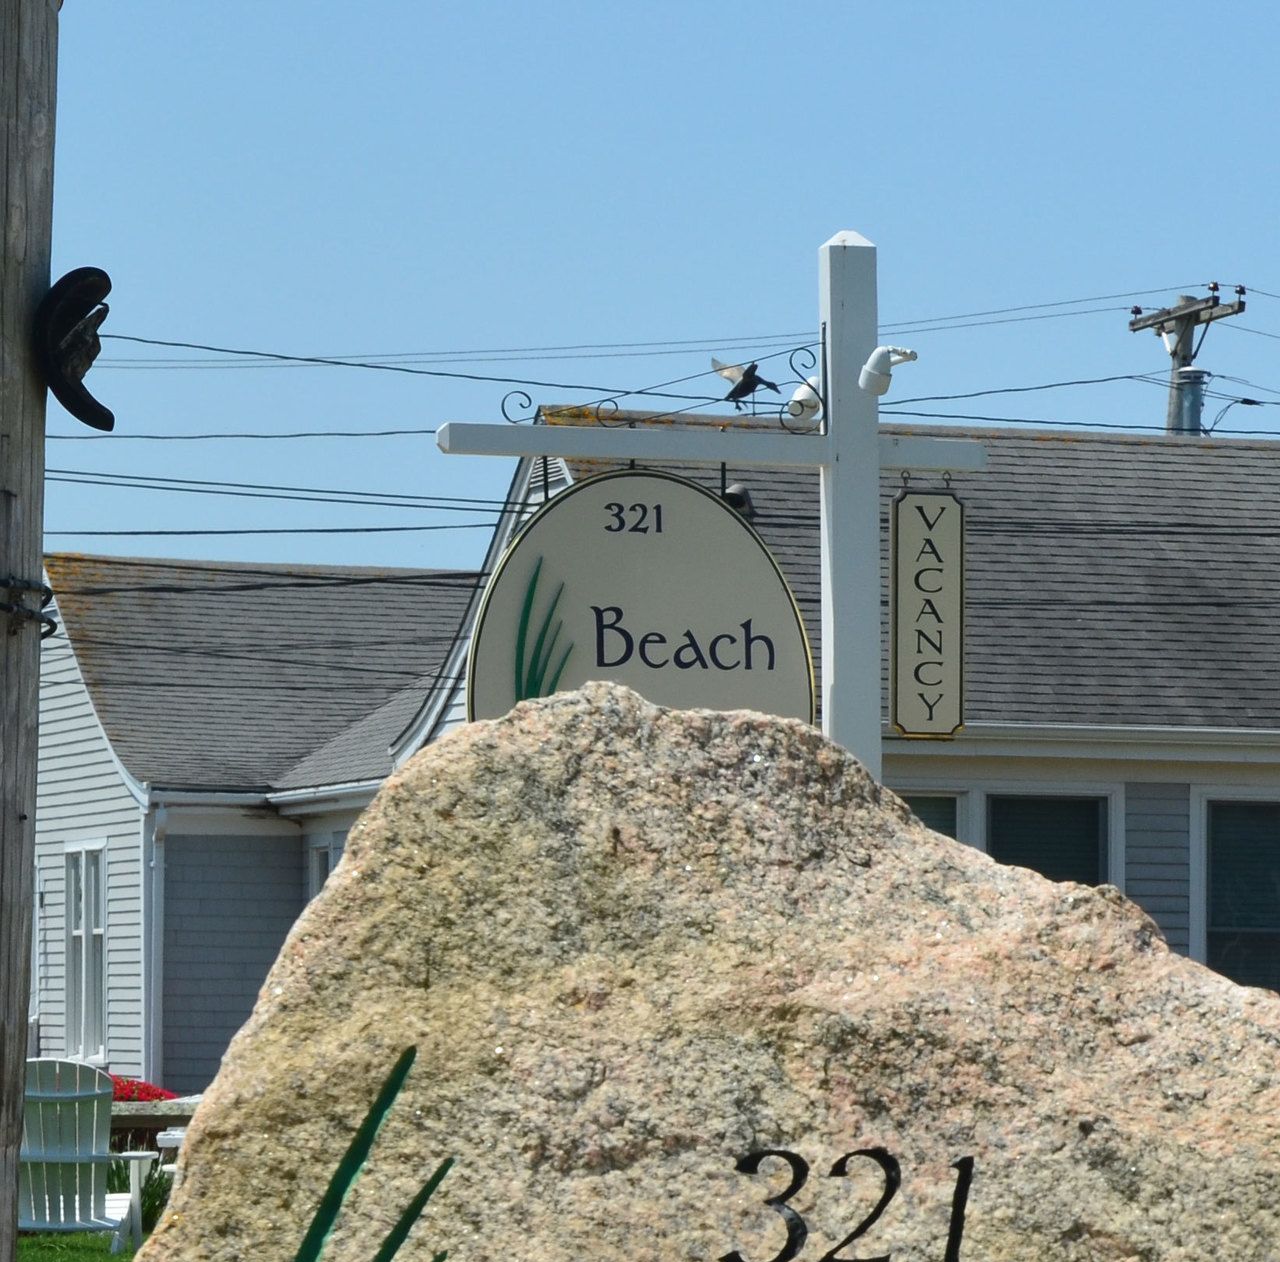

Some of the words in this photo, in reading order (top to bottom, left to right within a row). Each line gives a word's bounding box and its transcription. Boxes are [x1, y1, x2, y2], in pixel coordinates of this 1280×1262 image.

[604, 503, 663, 534] 321
[590, 606, 775, 671] Beach
[914, 506, 946, 722] VACANCY
